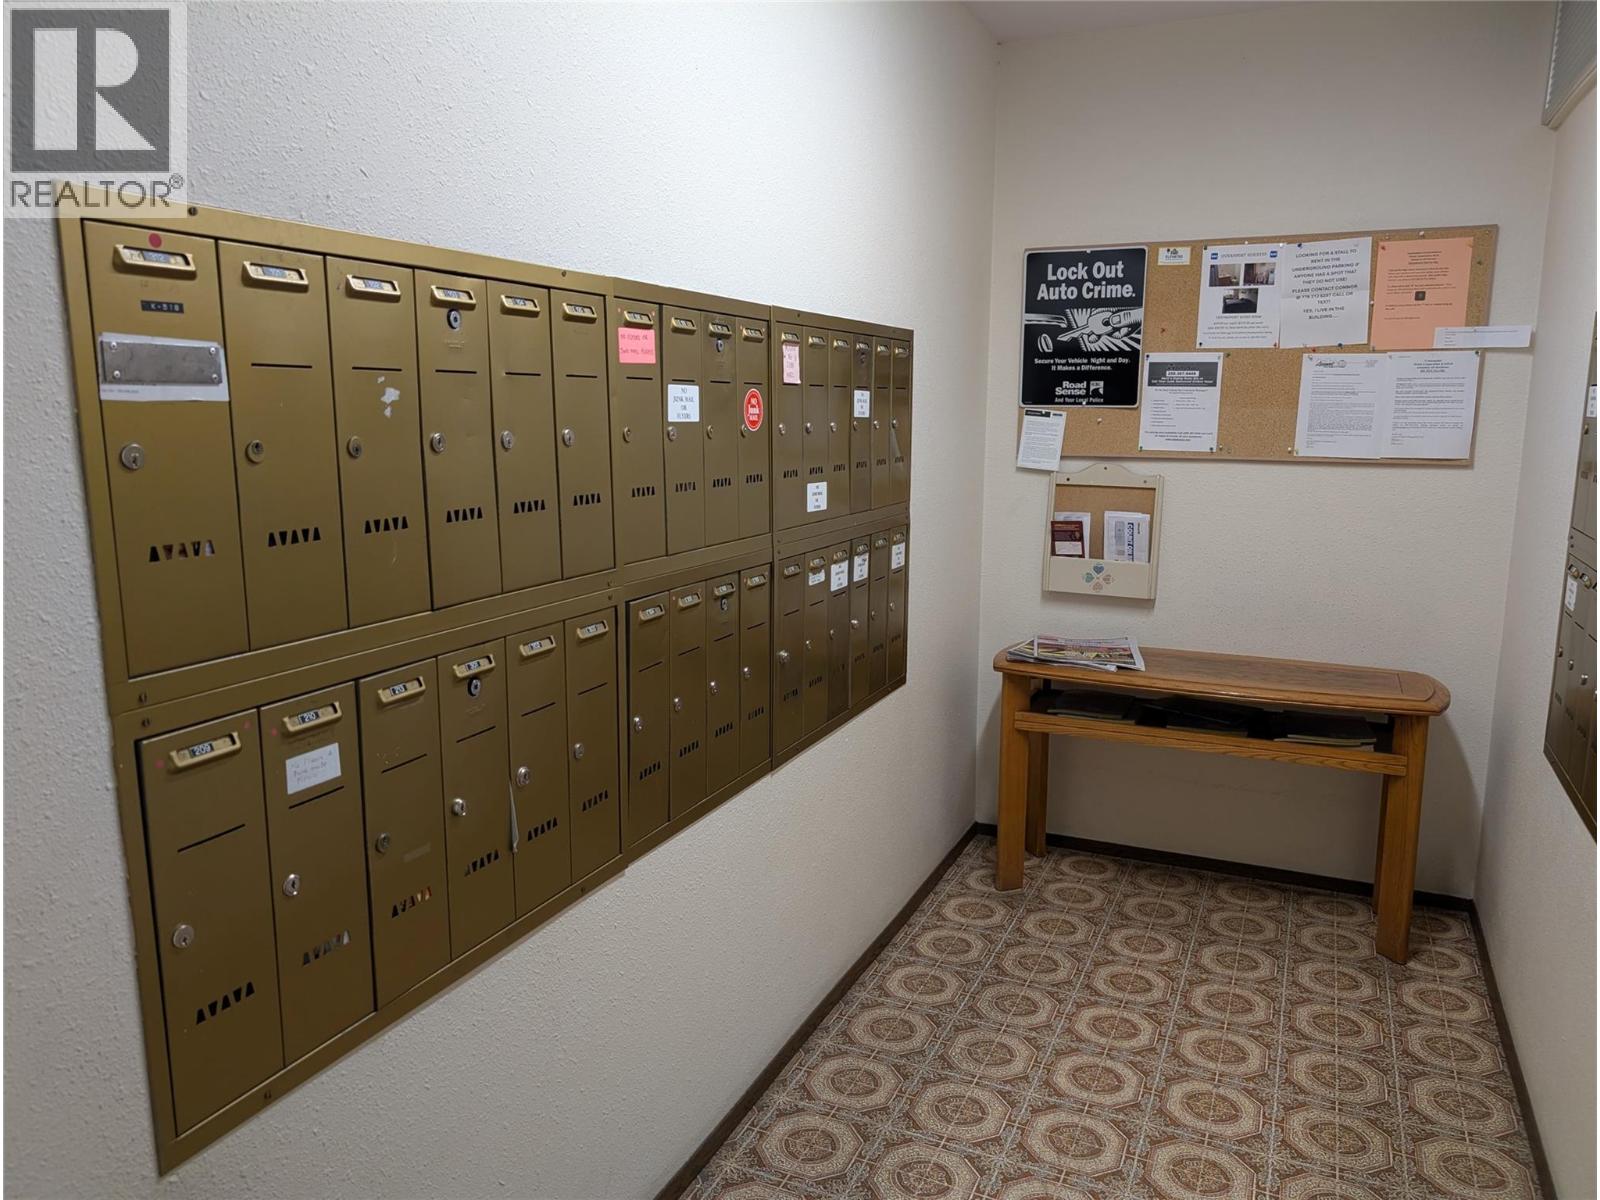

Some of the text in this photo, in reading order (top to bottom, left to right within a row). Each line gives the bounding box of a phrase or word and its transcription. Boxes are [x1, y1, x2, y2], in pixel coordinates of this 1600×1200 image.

[1047, 260, 1125, 281] Lock Out
[1036, 281, 1136, 301] Auto Crime.
[1090, 357, 1106, 365] Night
[1055, 387, 1086, 396] Sense
[748, 404, 760, 414] Junk
[194, 744, 211, 755] 209
